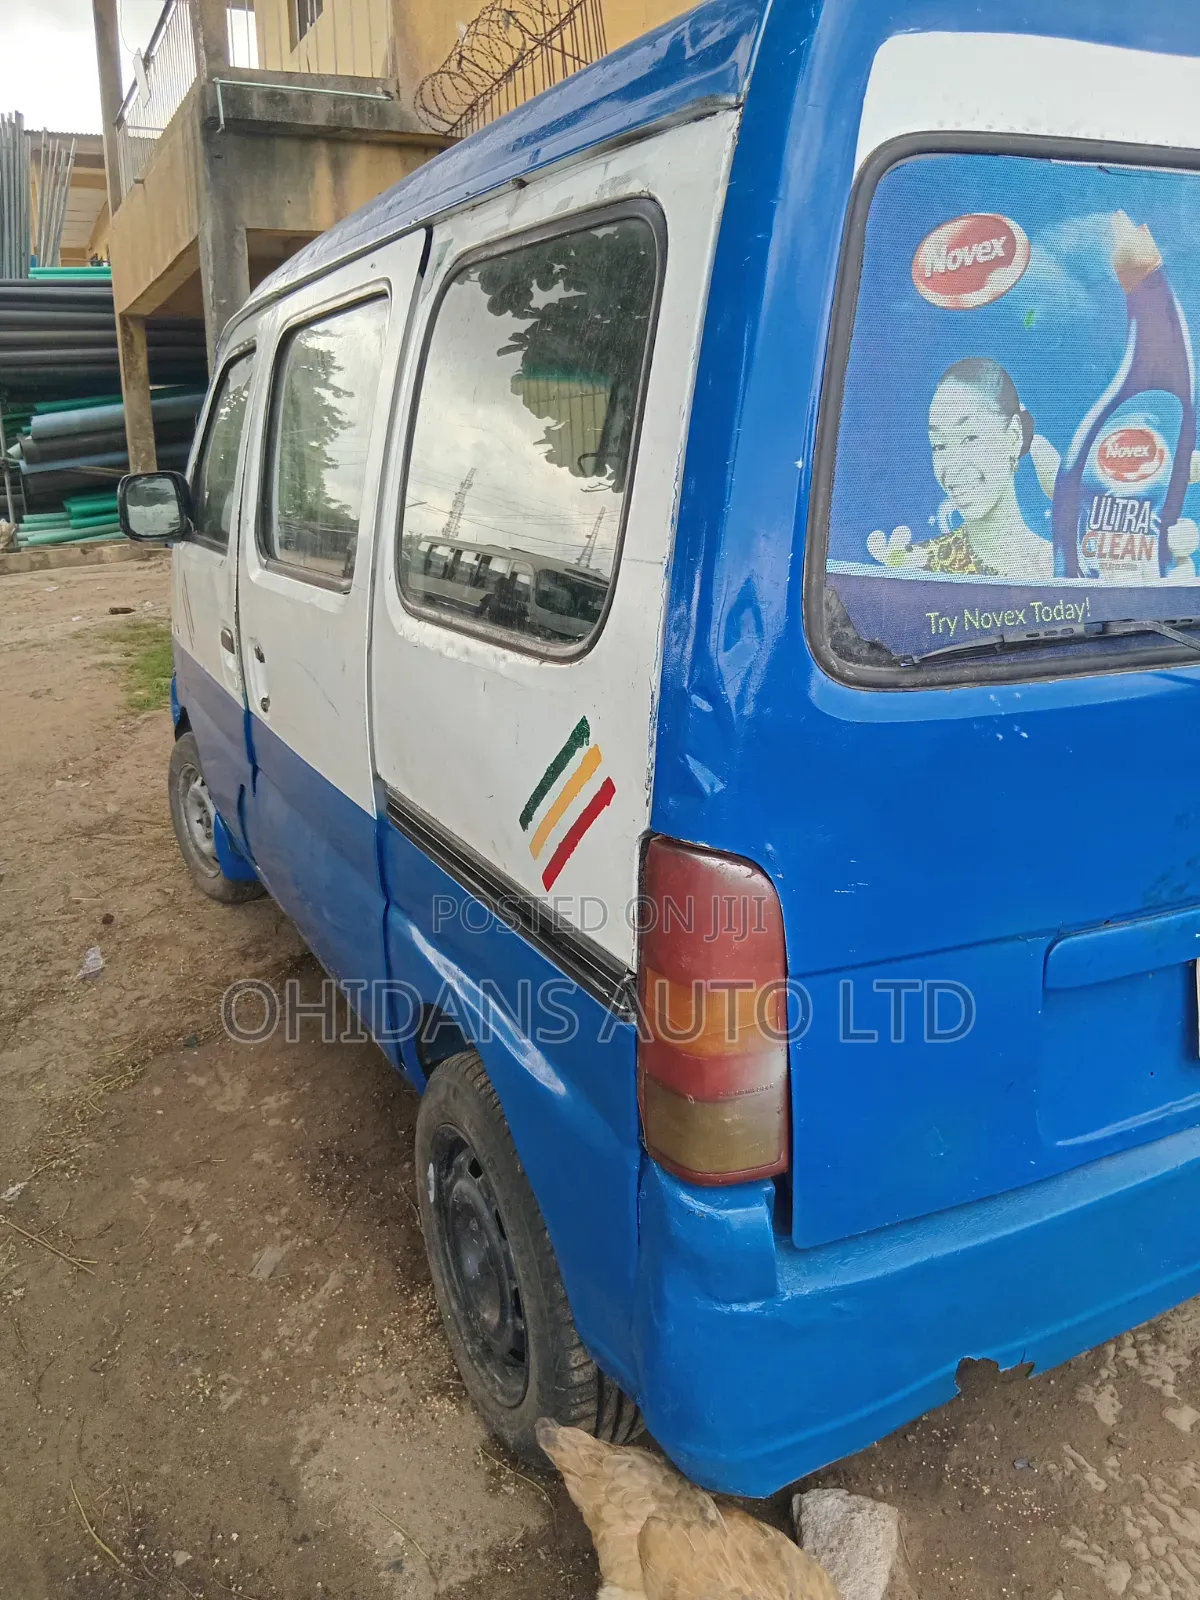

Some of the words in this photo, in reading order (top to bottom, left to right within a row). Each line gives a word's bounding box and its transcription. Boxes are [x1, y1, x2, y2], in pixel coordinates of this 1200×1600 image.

[924, 236, 1007, 278] Novex
[1105, 442, 1150, 459] Novex
[1089, 494, 1152, 535] ULTRA
[1081, 531, 1155, 562] CLEAN
[925, 611, 958, 637] Try
[963, 607, 1027, 632] Novex
[1029, 596, 1091, 624] Today!
